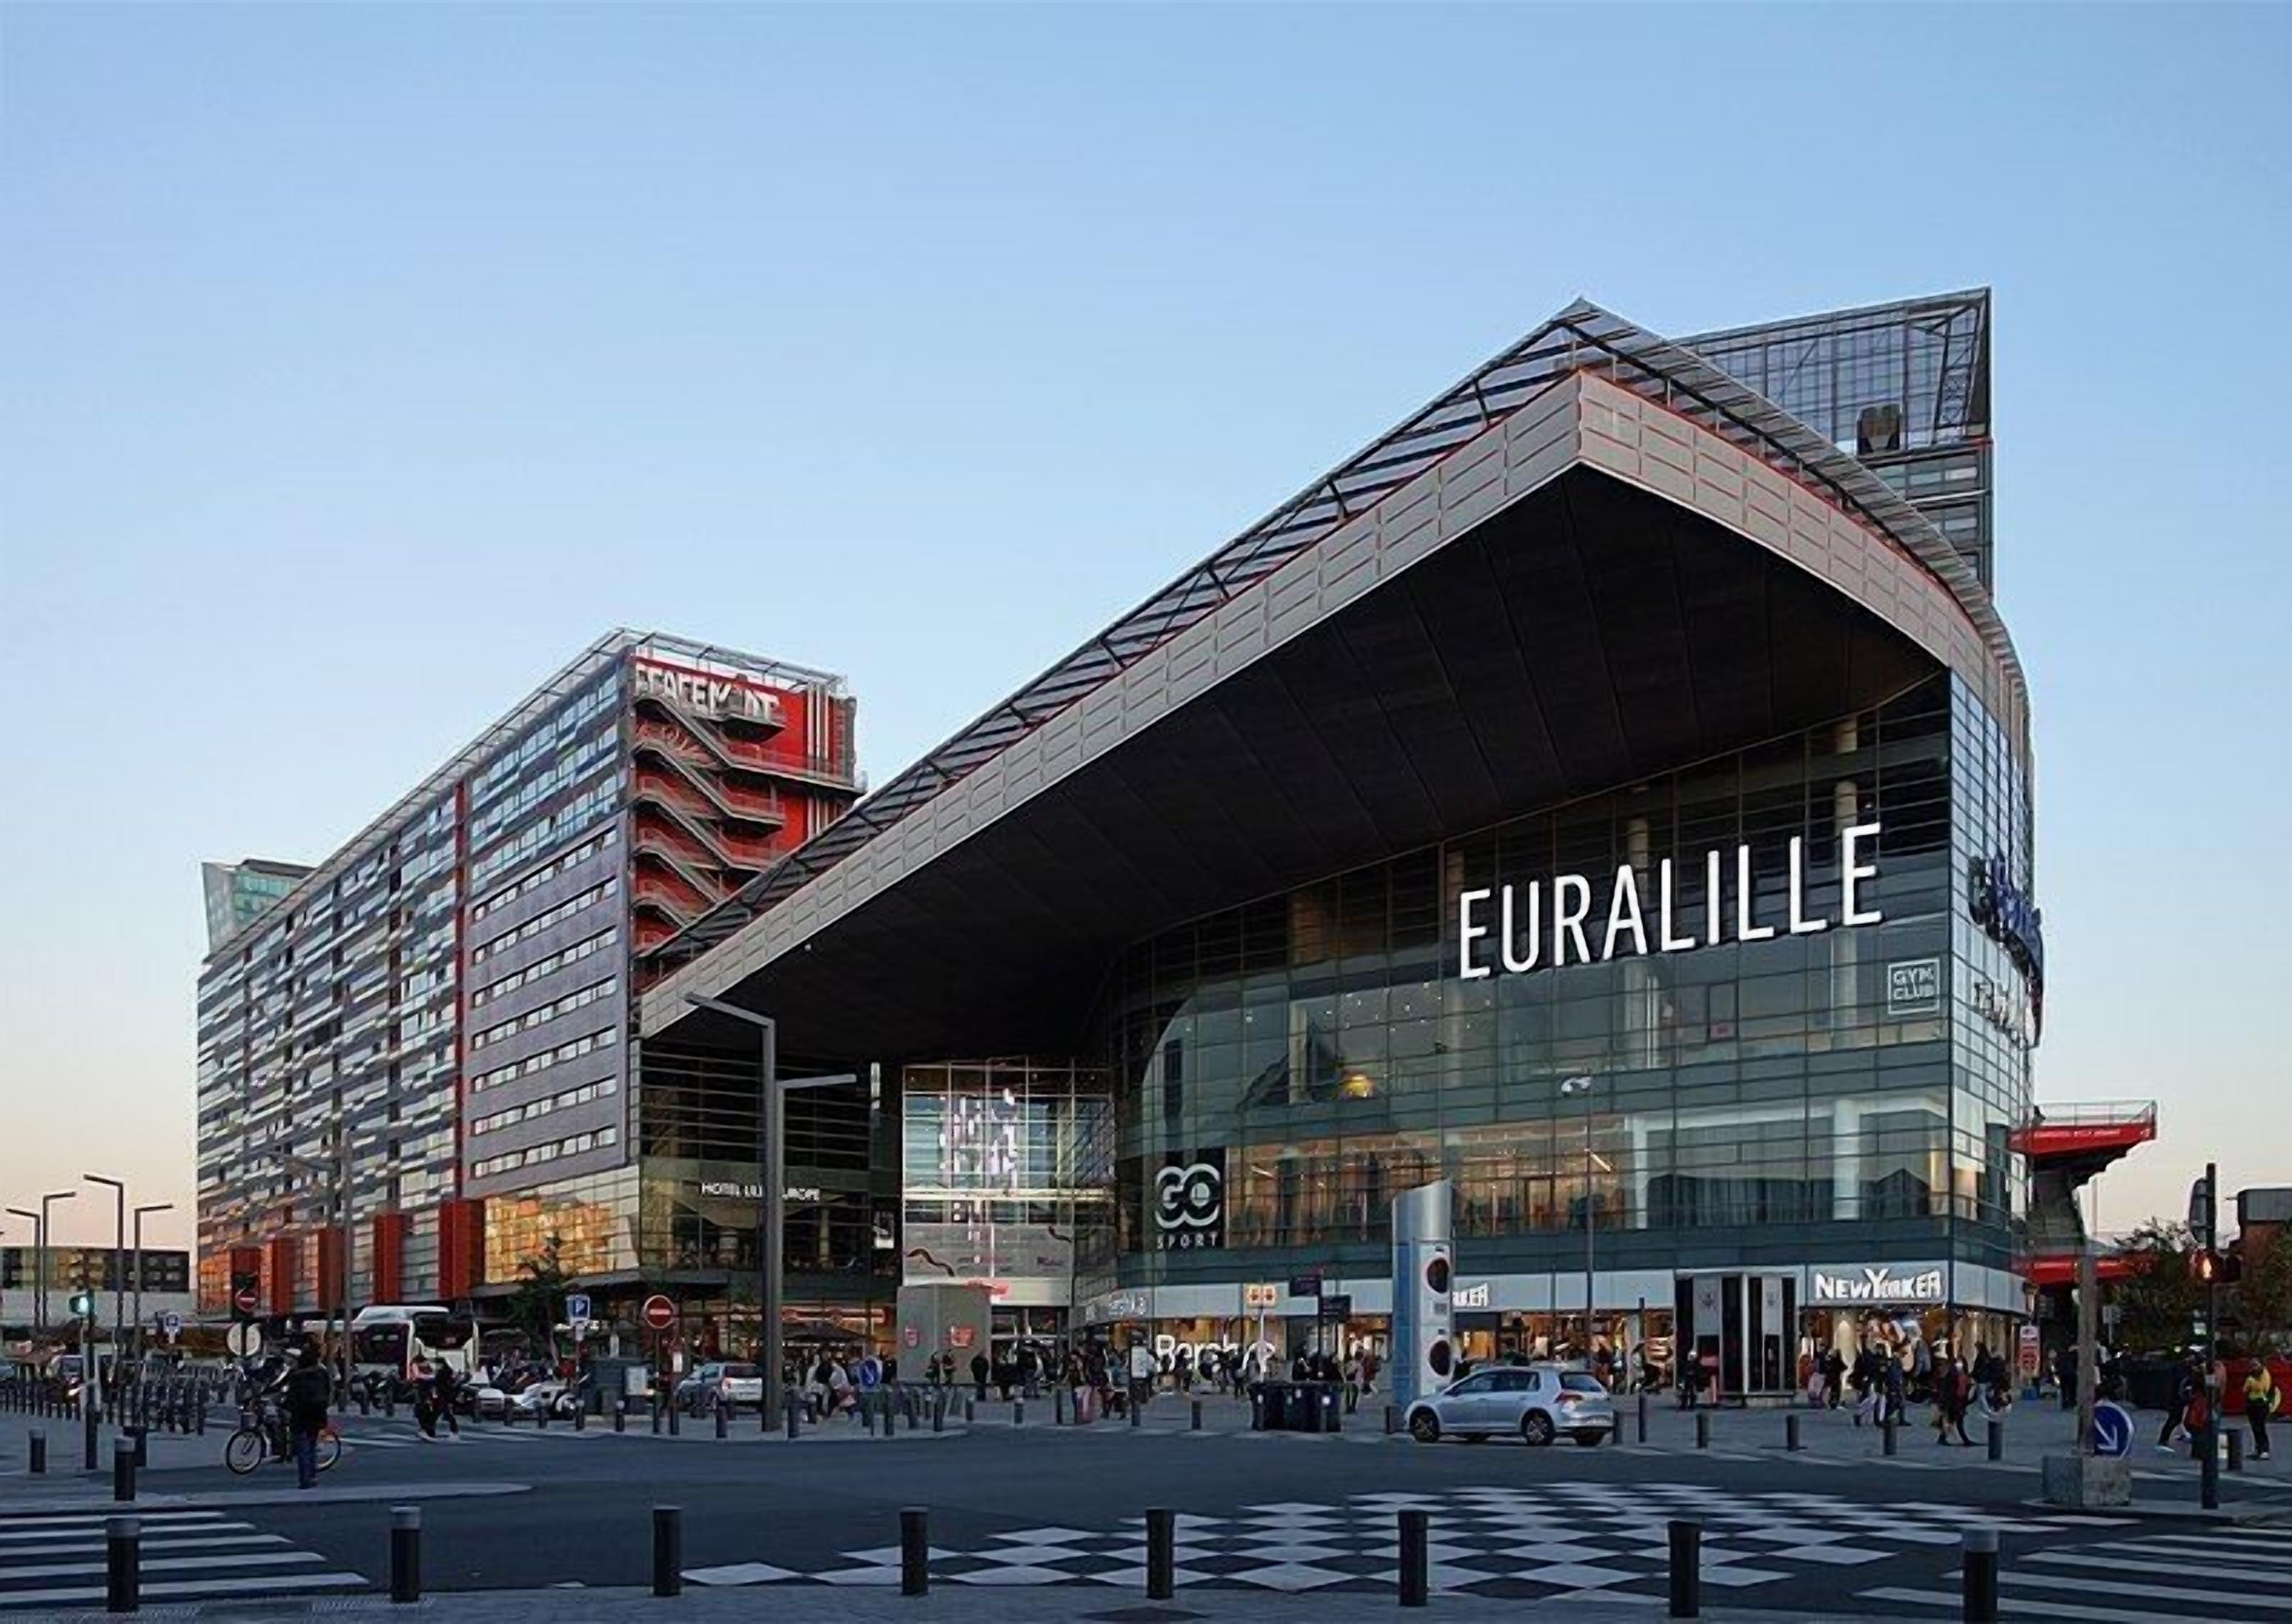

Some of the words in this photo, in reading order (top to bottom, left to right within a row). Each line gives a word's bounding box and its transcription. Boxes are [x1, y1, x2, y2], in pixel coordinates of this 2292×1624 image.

[1460, 822, 1882, 979] EURALILLE
[1155, 1163, 1220, 1229] GO
[1157, 1232, 1218, 1250] SPORT
